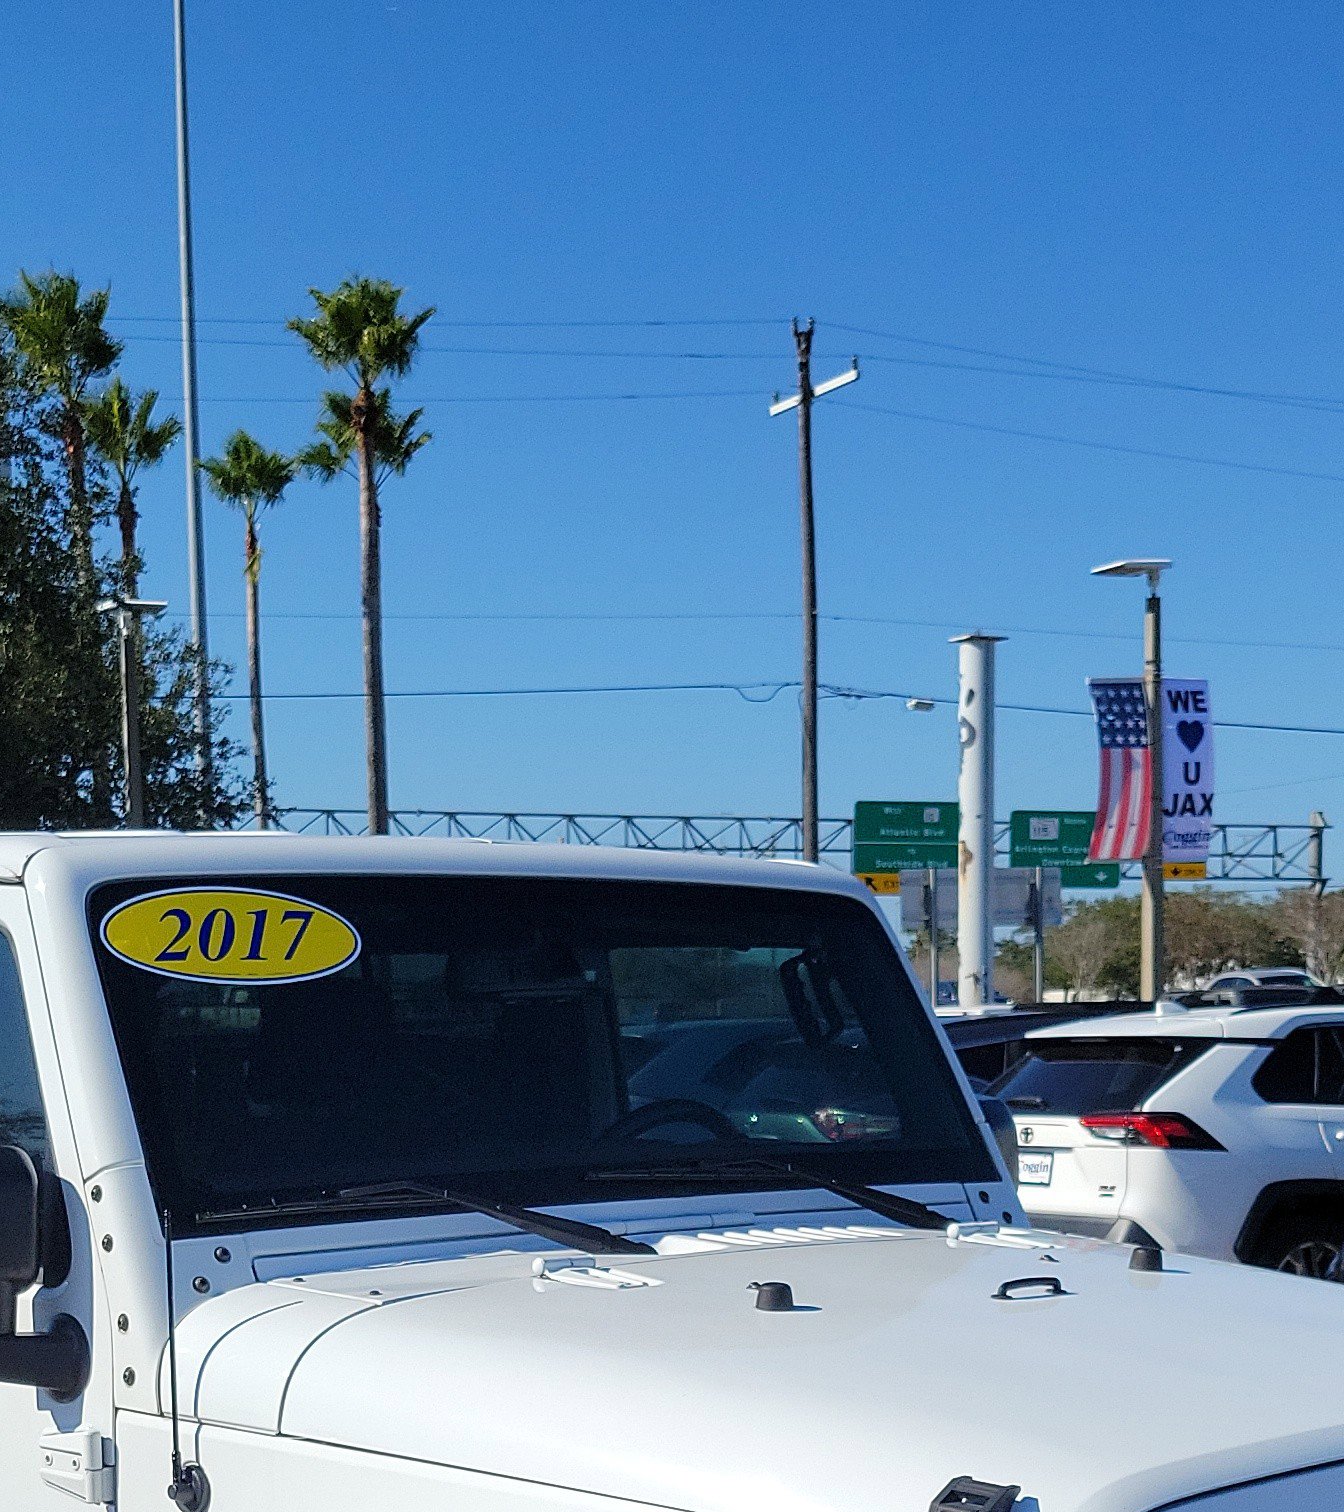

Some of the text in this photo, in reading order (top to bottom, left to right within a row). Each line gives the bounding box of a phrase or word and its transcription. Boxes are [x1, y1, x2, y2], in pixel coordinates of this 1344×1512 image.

[1167, 690, 1208, 713] WE
[1183, 761, 1201, 786] U
[1162, 793, 1214, 818] JAX
[154, 908, 316, 962] 2017
[1019, 1159, 1049, 1174] oggin
